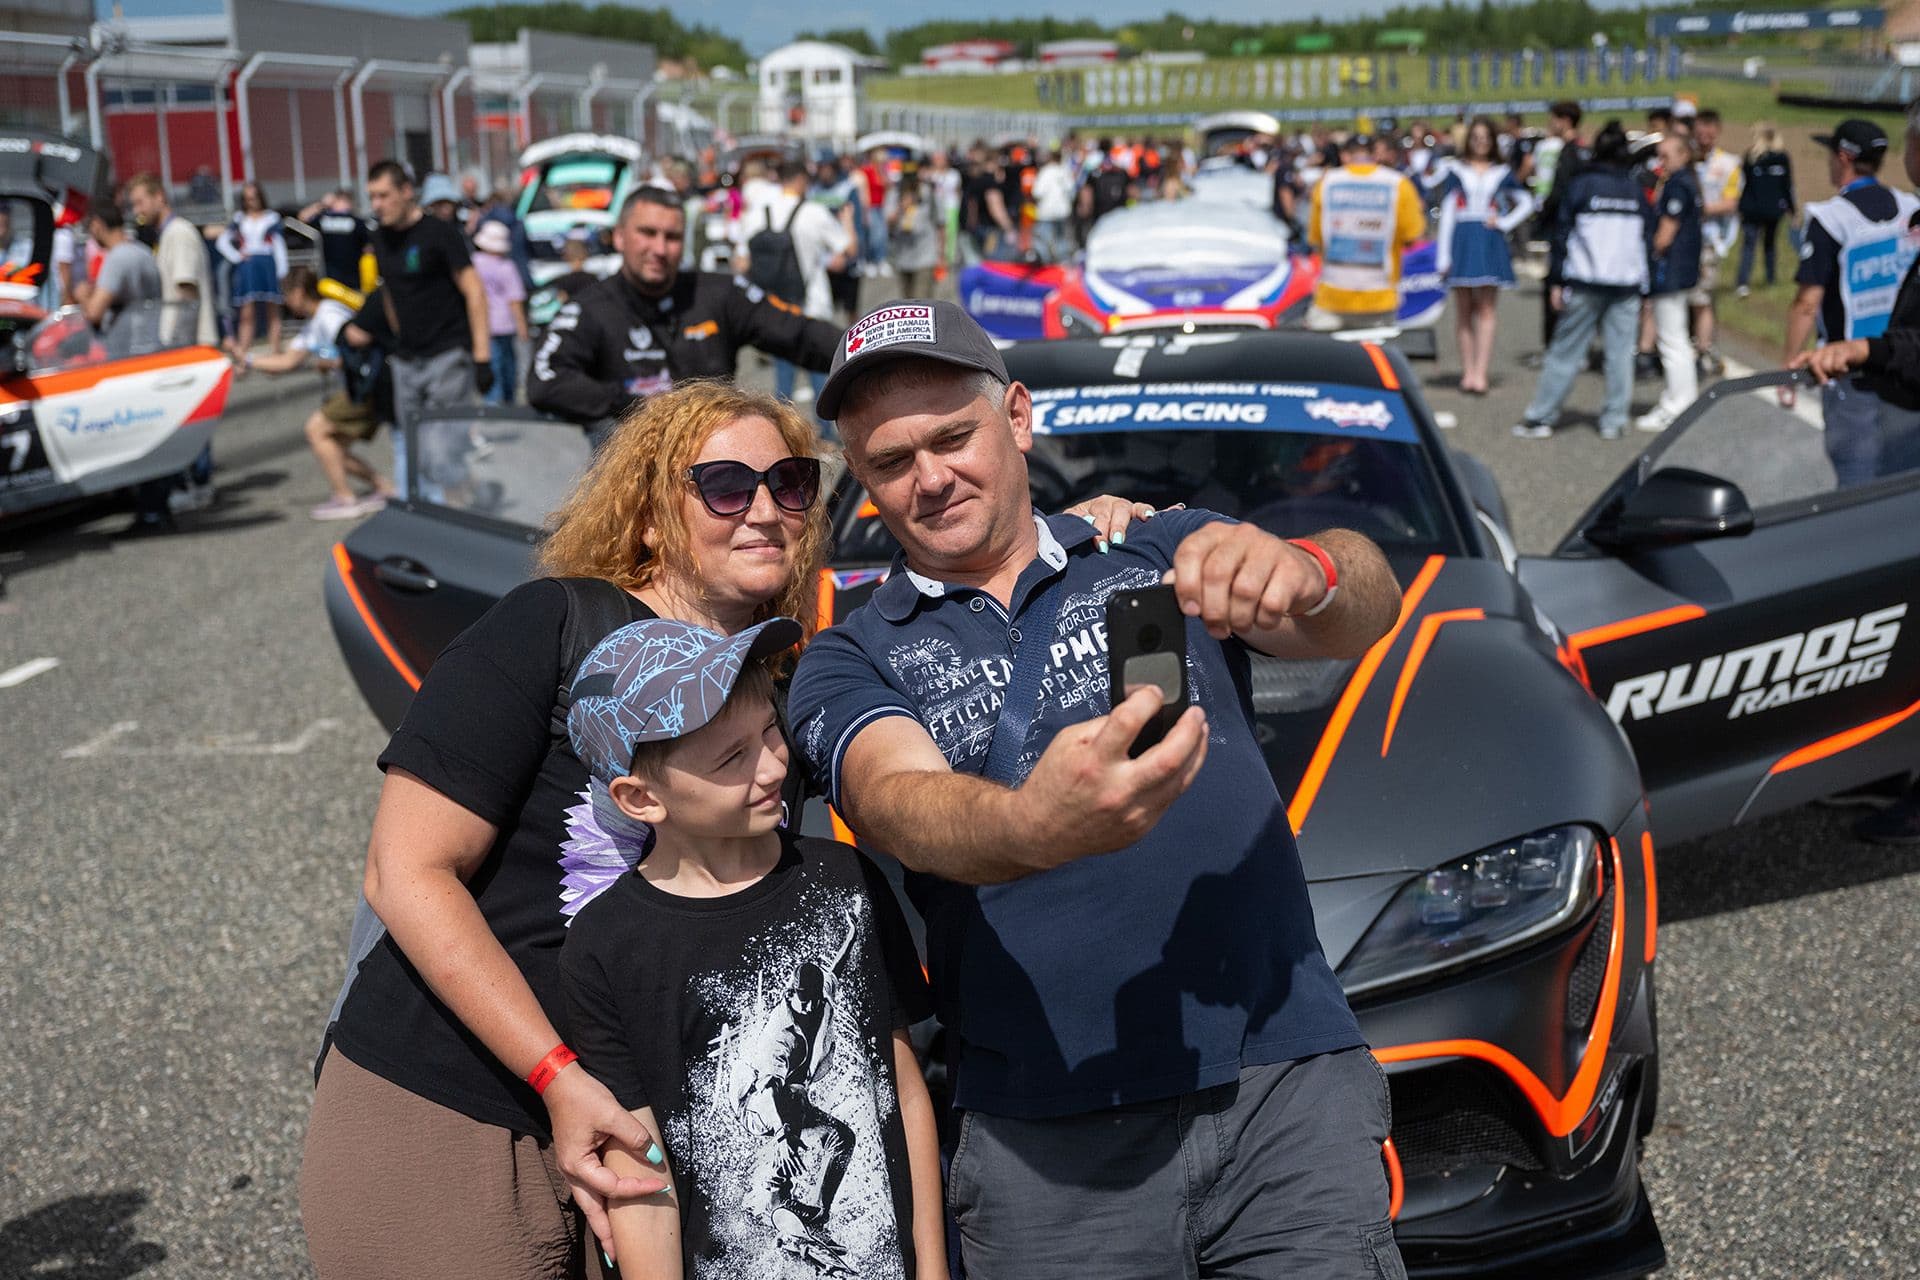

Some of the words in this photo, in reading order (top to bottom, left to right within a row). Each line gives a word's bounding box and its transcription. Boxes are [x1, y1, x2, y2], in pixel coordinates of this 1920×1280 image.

[849, 307, 928, 337] TORONTO
[865, 324, 885, 337] BORN
[886, 321, 895, 330] IN
[897, 319, 930, 327] CANADA
[865, 332, 884, 344] MADE
[896, 326, 931, 335] AMERICA
[1053, 403, 1133, 426] SMP
[1134, 402, 1268, 424] RACING
[1056, 607, 1099, 636] WORLD
[1605, 603, 1908, 724] RUMOS
[1060, 685, 1086, 709] EAST
[1727, 652, 1891, 720] RACING
